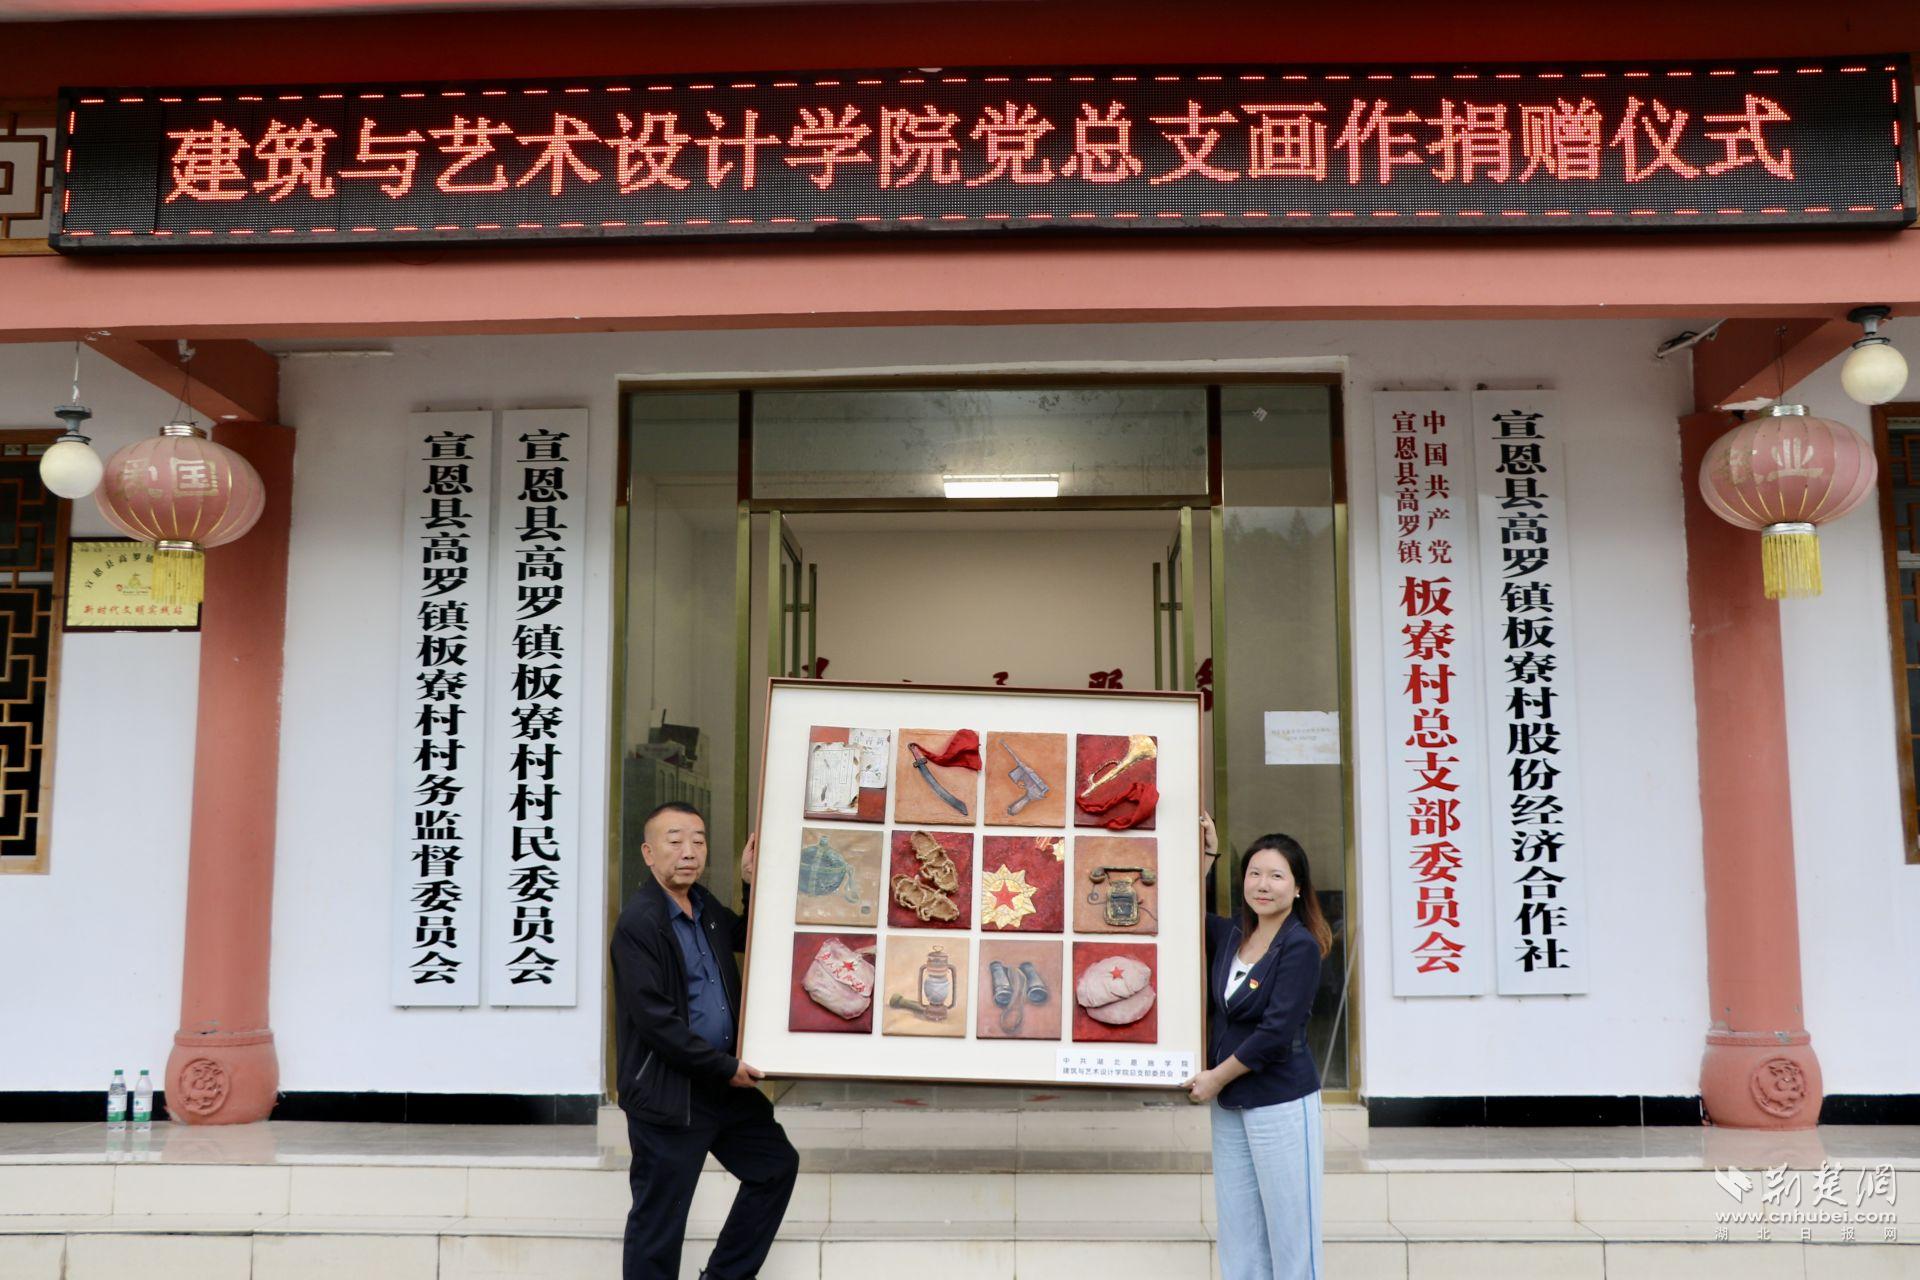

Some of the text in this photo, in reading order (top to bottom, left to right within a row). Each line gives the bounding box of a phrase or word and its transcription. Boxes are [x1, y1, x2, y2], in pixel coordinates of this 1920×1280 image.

[164, 94, 1794, 204] 建筑与艺术设计学院党总支画作捐赠仪式
[1392, 410, 1422, 563] 宣恩县高罗镇
[1422, 410, 1452, 564] 中国共产党
[409, 431, 475, 984] 宣恩县高罗镇板寮村村务监督委员会
[508, 428, 570, 984] 宣恩县高罗镇板寮村村民委员会
[1399, 576, 1466, 973] 板寮村总支部委员会
[1492, 410, 1570, 972] 宣恩县高罗镇板寮村股份经济合作社
